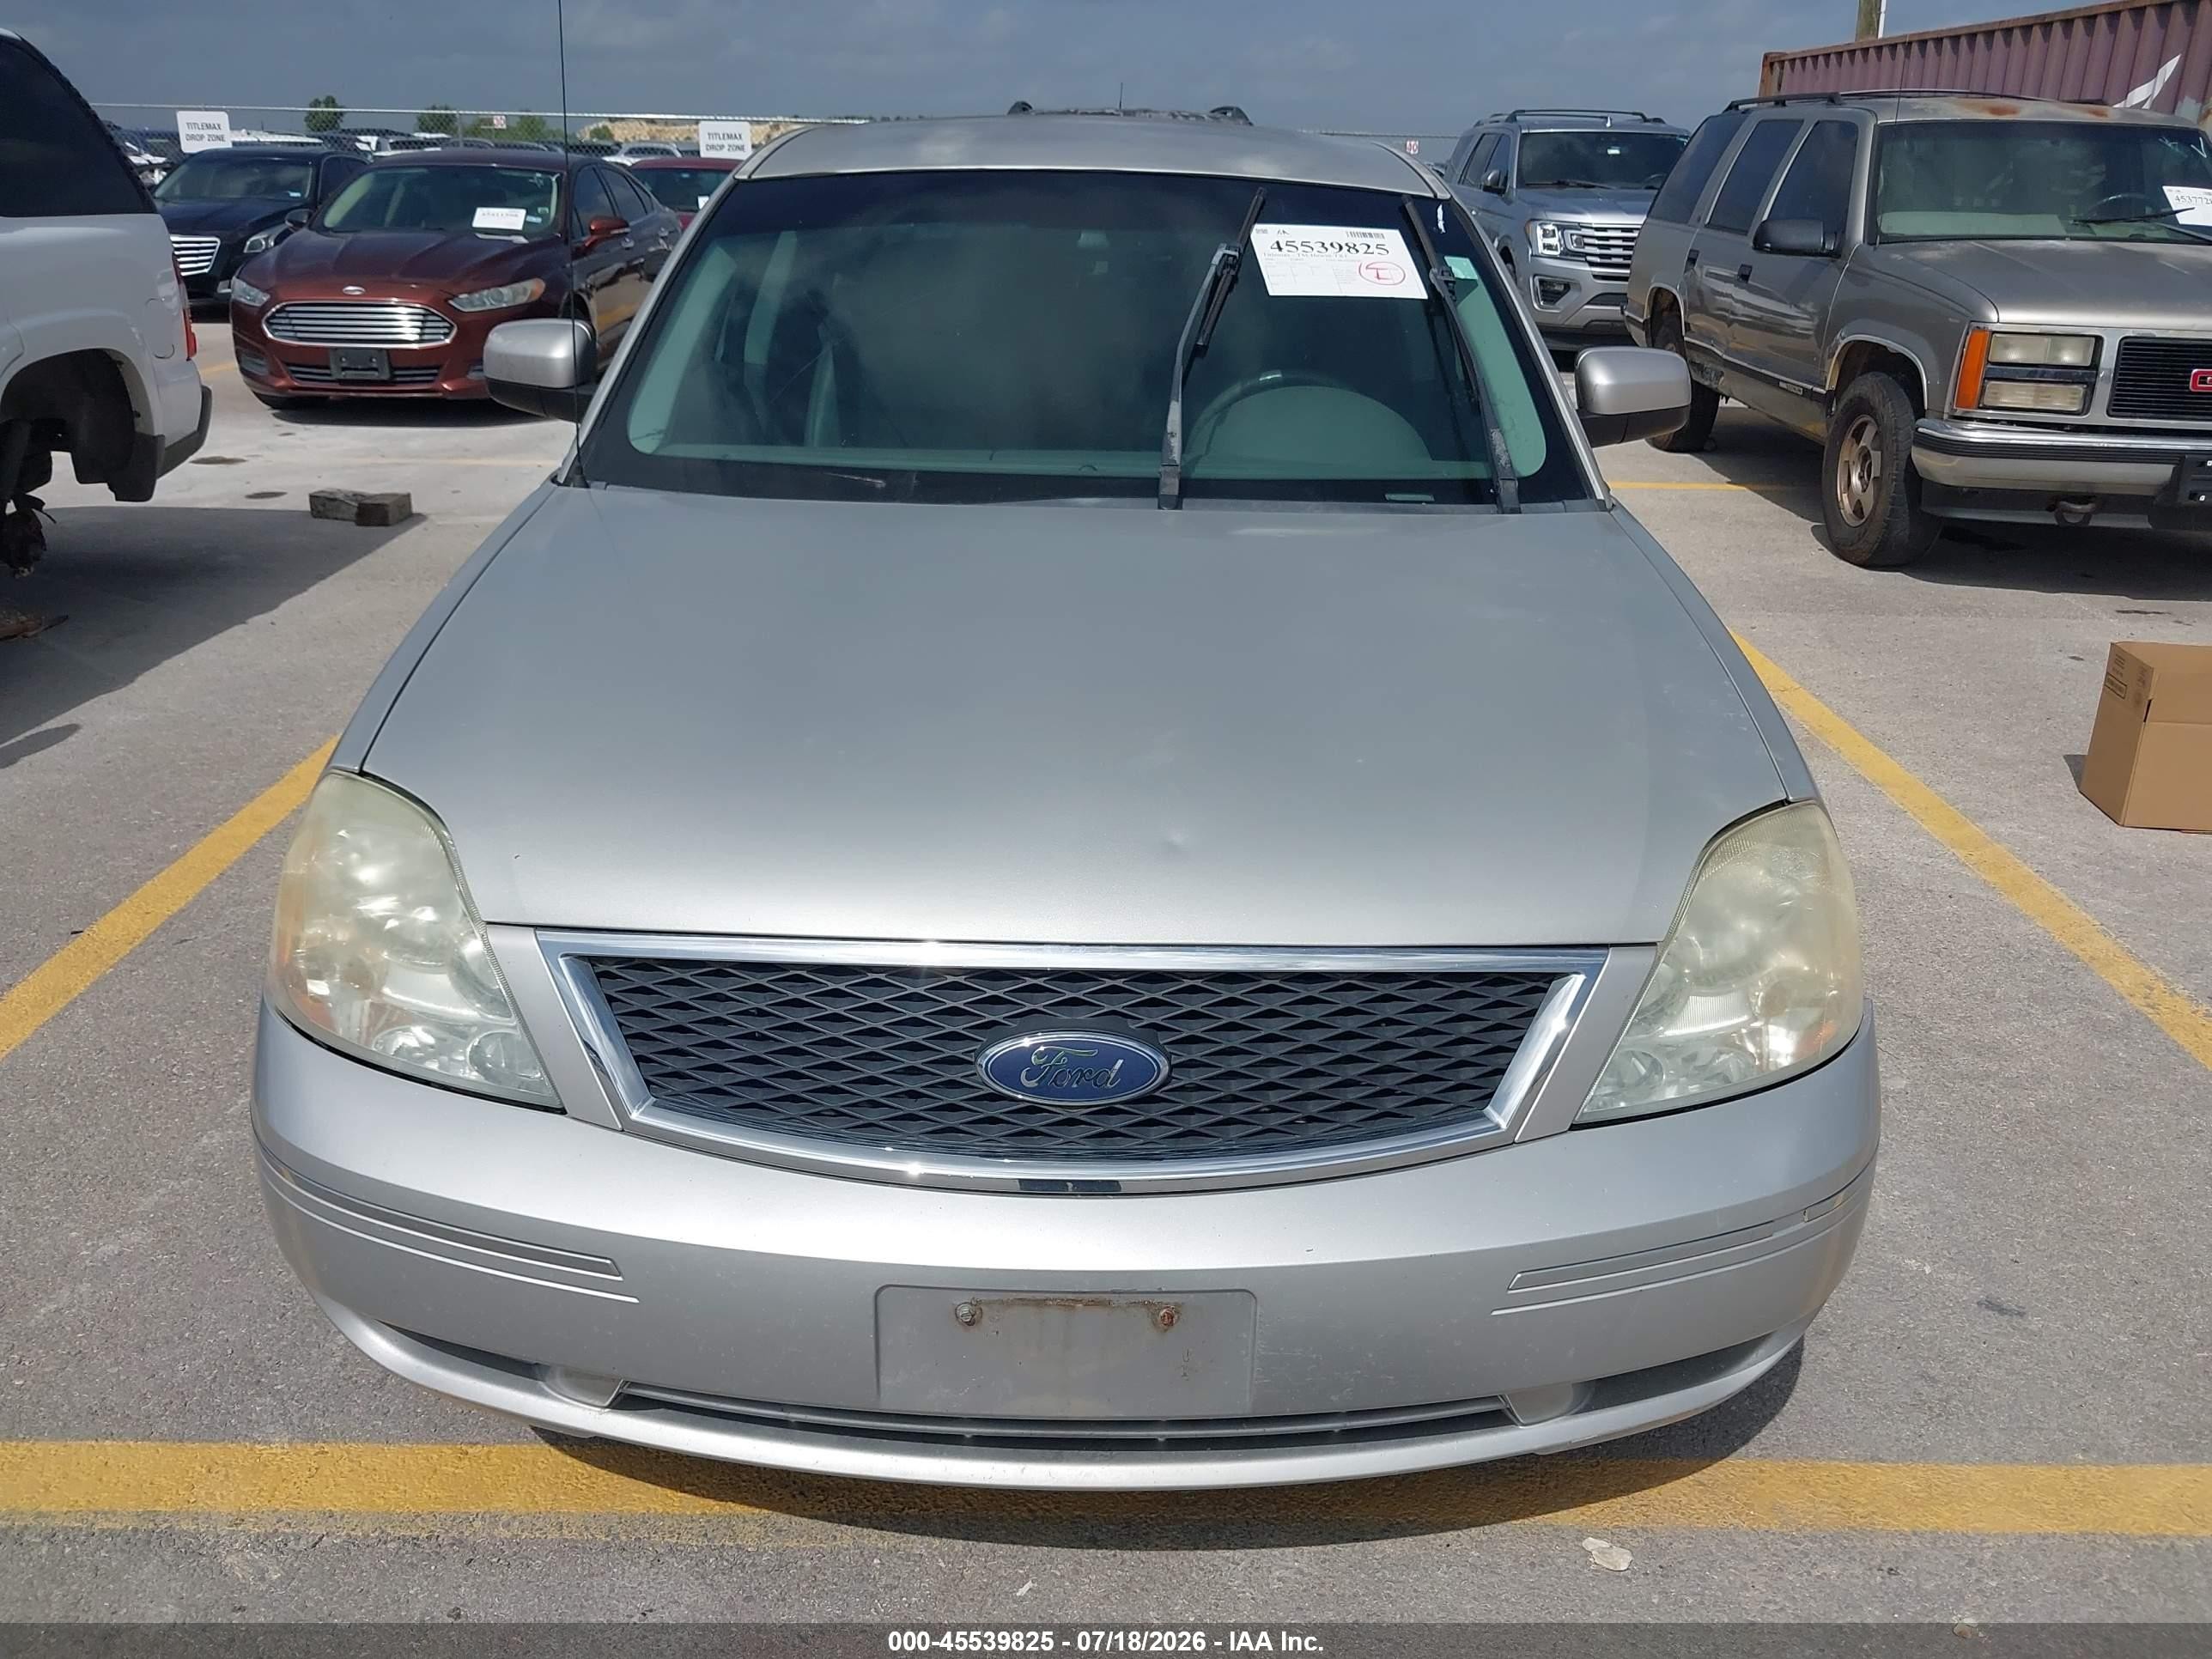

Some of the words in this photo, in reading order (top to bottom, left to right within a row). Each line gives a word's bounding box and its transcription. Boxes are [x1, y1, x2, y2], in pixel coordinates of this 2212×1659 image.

[185, 122, 222, 131] TITLEMAX
[185, 133, 205, 142] DROP
[207, 133, 227, 143] ZONE
[707, 131, 743, 141] TITLEMAX
[706, 143, 725, 152] DROP
[727, 143, 746, 153] ZONE
[1270, 240, 1390, 256] 45539825
[1020, 1045, 1125, 1088] Ford
